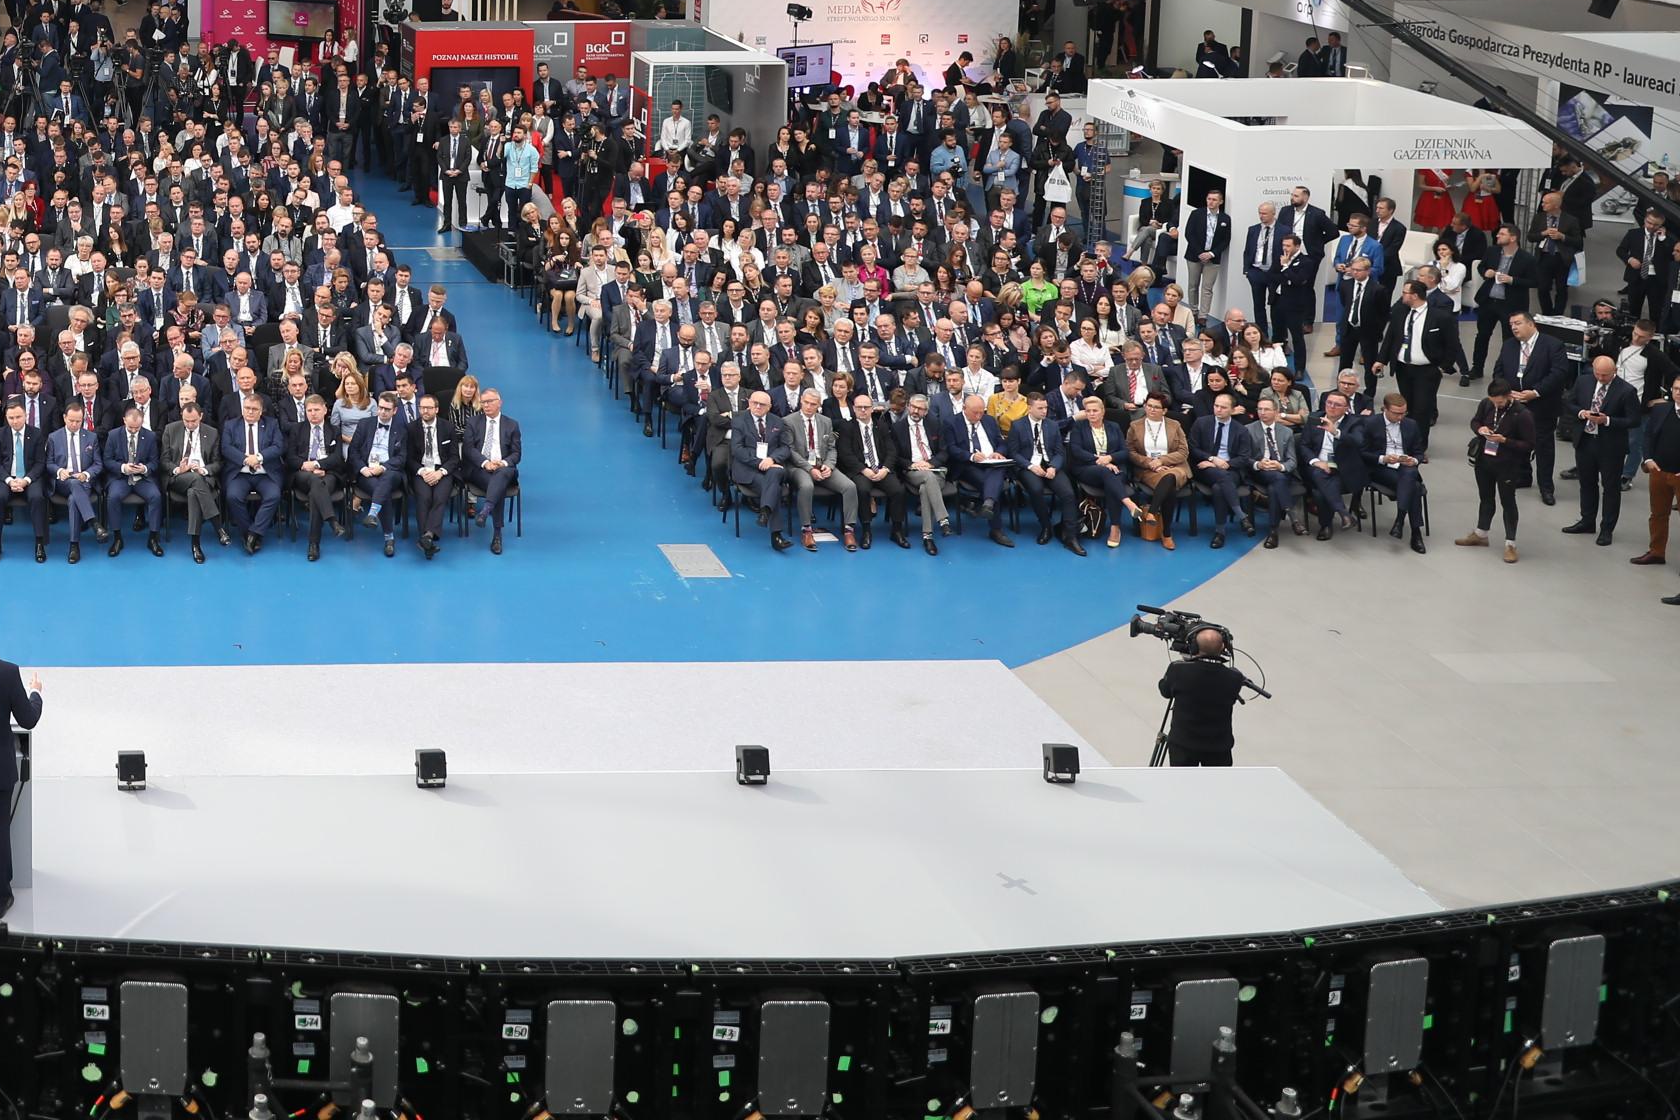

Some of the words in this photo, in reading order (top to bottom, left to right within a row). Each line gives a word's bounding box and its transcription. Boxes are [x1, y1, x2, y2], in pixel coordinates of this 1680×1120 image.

[827, 4, 862, 15] MEDIA
[585, 43, 610, 53] BGK
[432, 54, 460, 62] POZNAJ
[1402, 19, 1446, 41] Nagroda
[1448, 29, 1520, 57] Gospodarcza
[1522, 44, 1590, 75] Prezydenta
[1594, 61, 1612, 78] RP
[1623, 67, 1676, 94] laureaci
[1110, 107, 1133, 125] GAZETA
[1133, 114, 1156, 132] PRAWNA
[1414, 138, 1476, 149] DZIENNIK
[1393, 149, 1439, 161] GAZETA
[1443, 149, 1492, 161] PRAWNA
